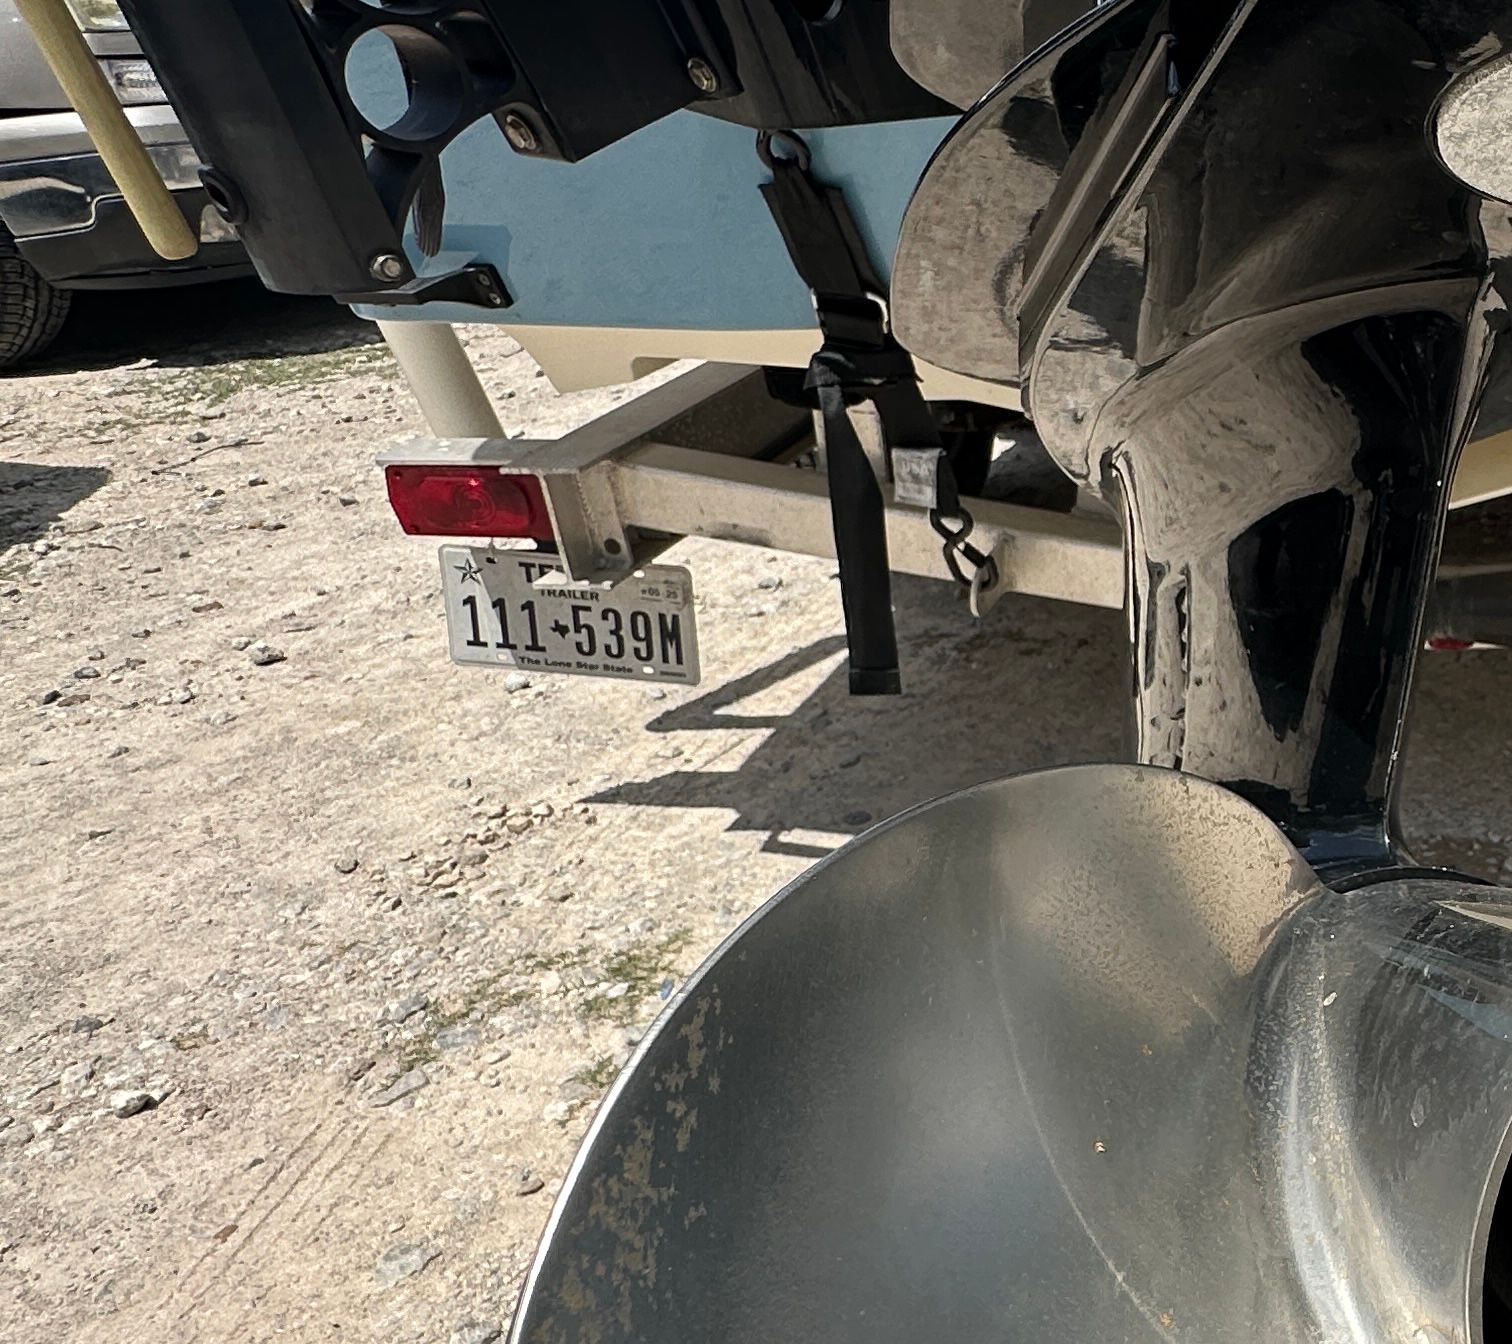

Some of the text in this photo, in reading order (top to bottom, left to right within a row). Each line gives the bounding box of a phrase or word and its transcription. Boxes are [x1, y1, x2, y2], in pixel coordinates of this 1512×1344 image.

[540, 588, 600, 603] TRAILER
[518, 656, 633, 674] The Lone Star State
